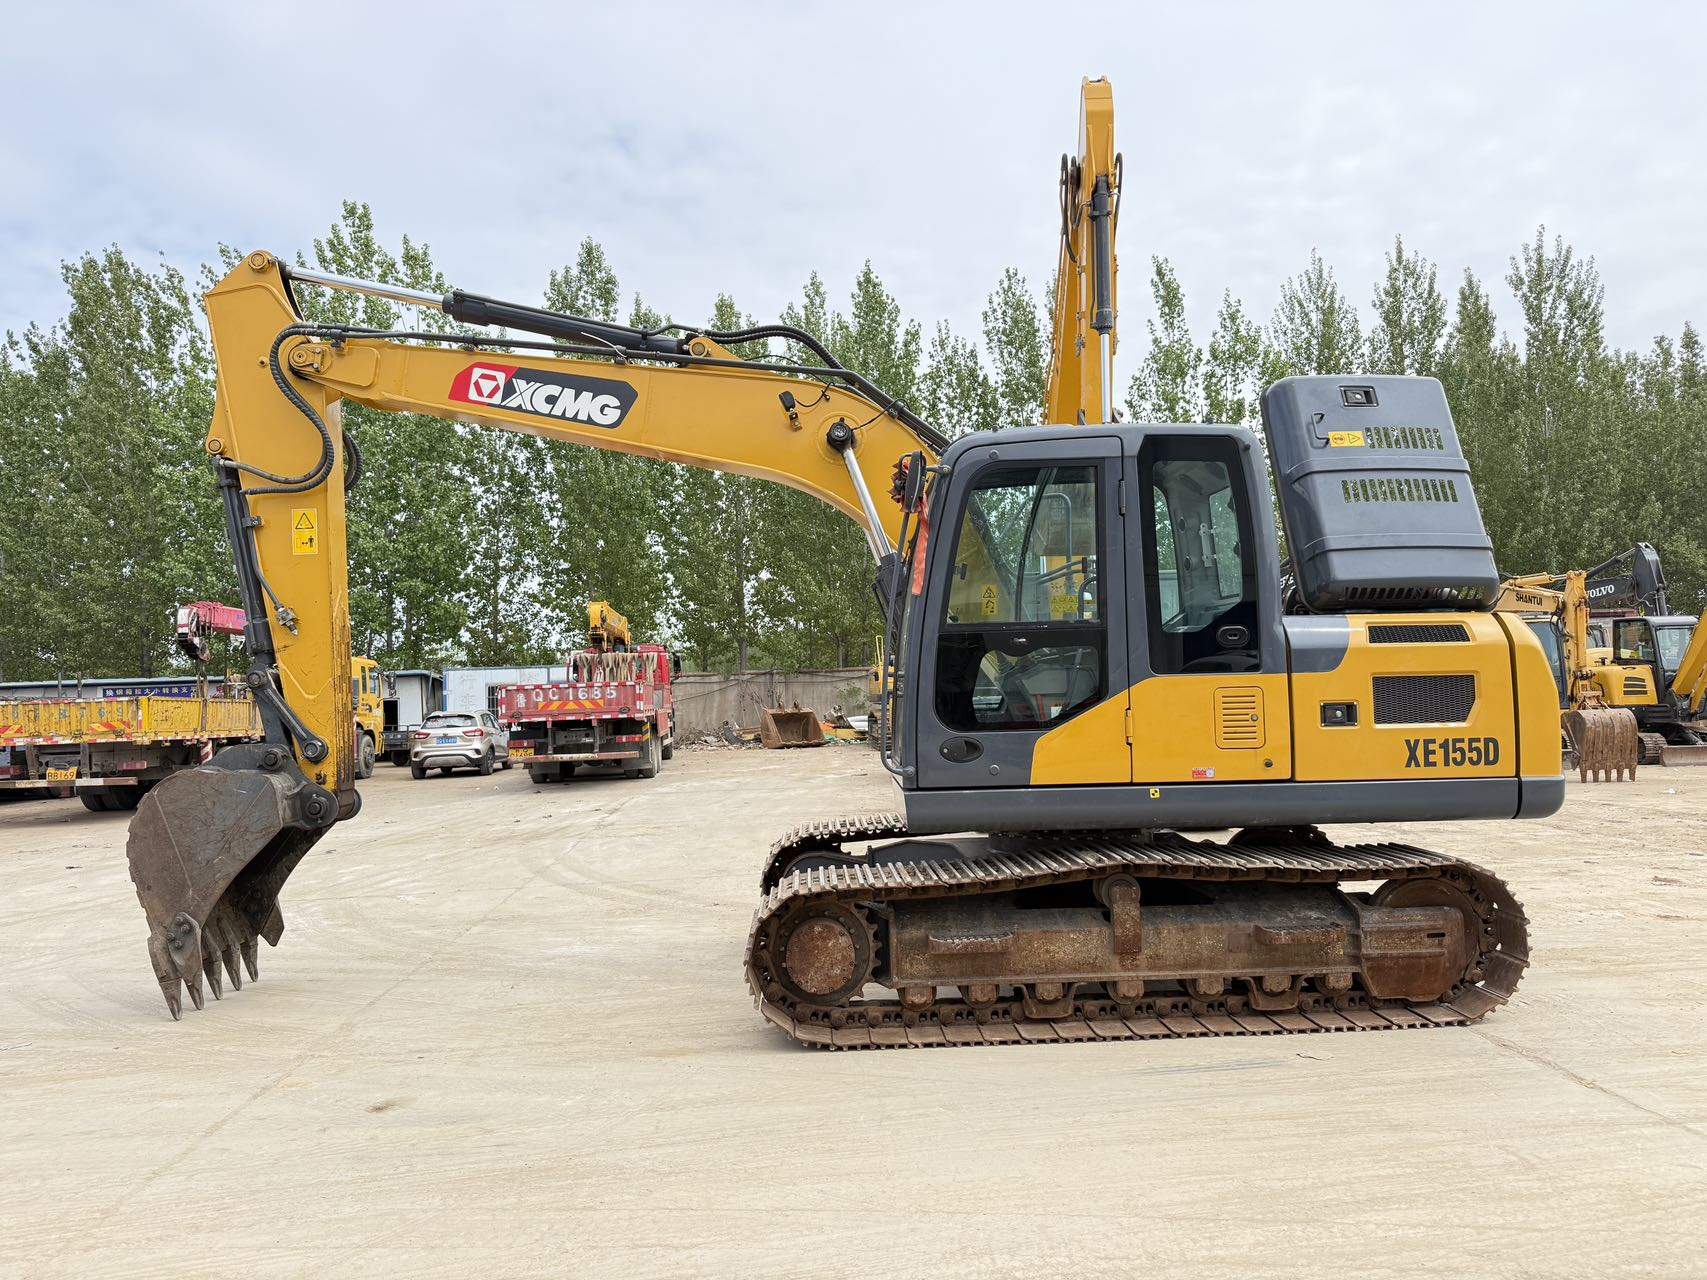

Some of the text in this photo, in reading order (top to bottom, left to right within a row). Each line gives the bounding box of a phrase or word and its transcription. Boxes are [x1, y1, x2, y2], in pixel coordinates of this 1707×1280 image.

[501, 378, 621, 426] XCMG
[1515, 592, 1543, 606] SHANTUI
[1404, 737, 1500, 769] XE155D
